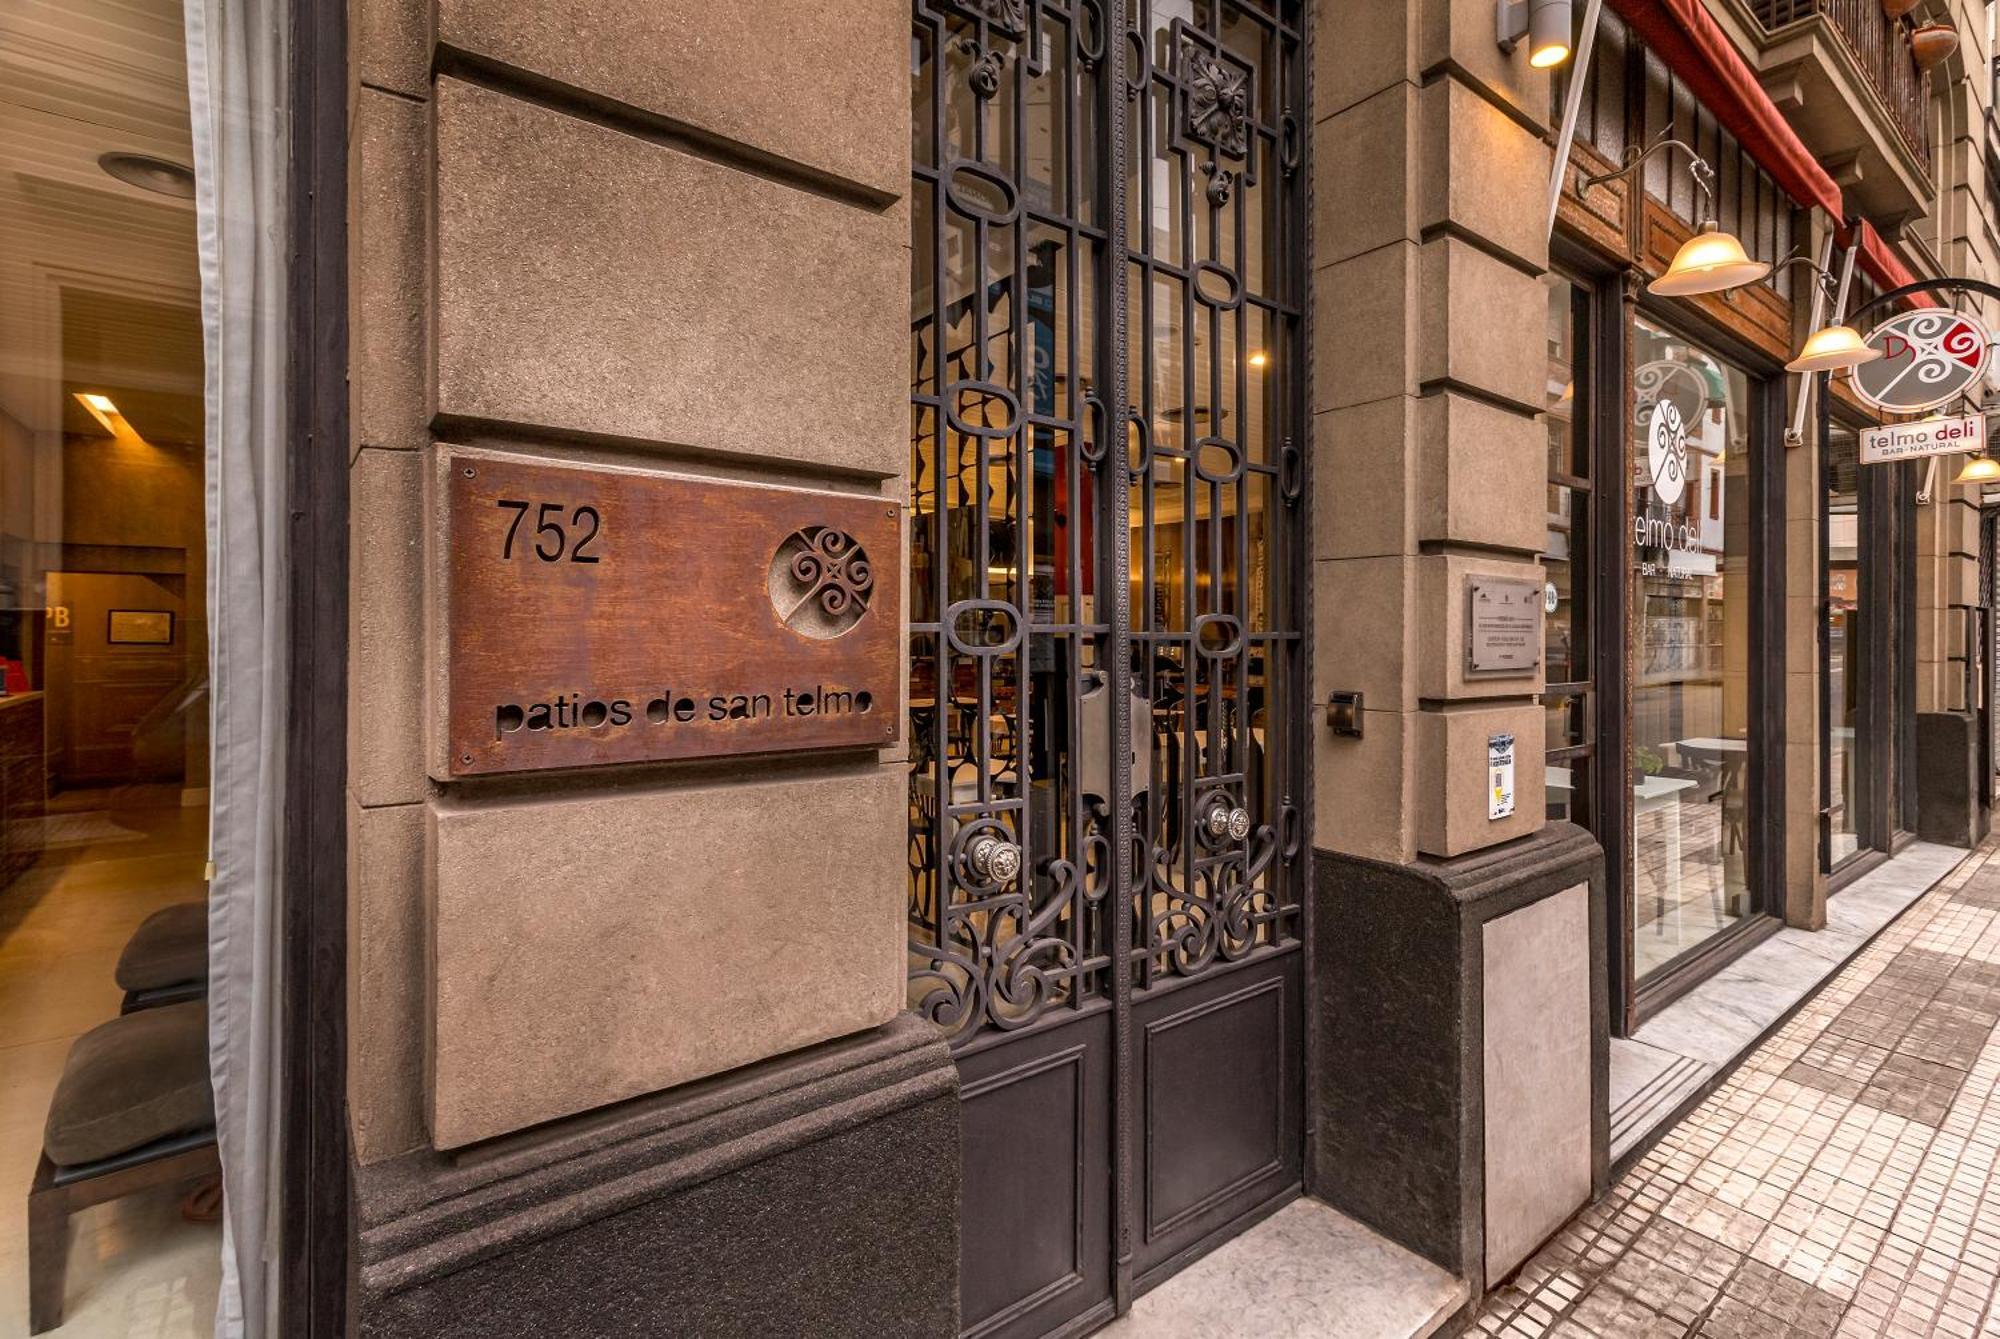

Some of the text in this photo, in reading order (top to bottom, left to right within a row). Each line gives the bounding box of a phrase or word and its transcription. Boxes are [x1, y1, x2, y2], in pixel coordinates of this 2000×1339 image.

[1869, 421, 1974, 449] telmo deli
[497, 500, 600, 564] 752
[495, 685, 873, 743] patios de san telmo
